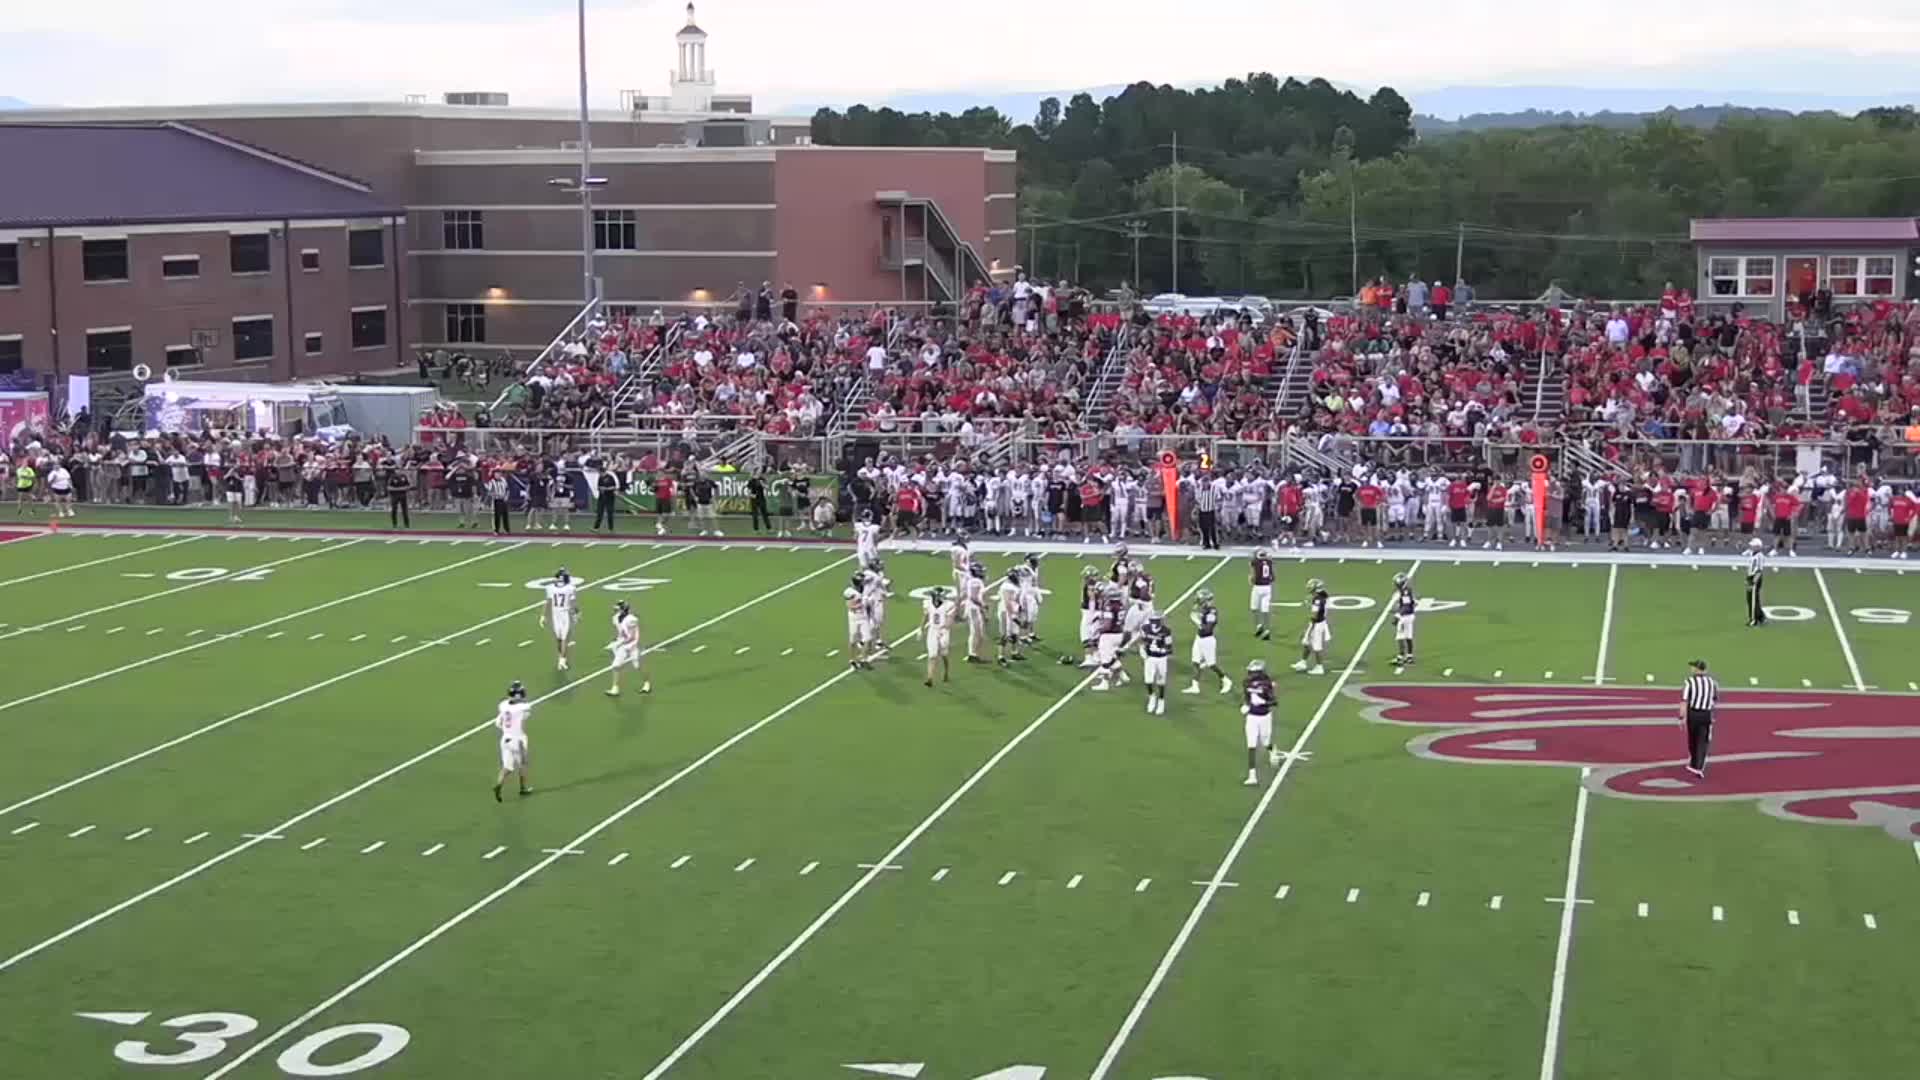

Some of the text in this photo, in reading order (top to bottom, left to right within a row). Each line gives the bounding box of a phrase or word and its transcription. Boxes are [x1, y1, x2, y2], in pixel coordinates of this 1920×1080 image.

[1200, 453, 1209, 469] 2
[553, 593, 566, 607] 17
[113, 1011, 411, 1076] 30
